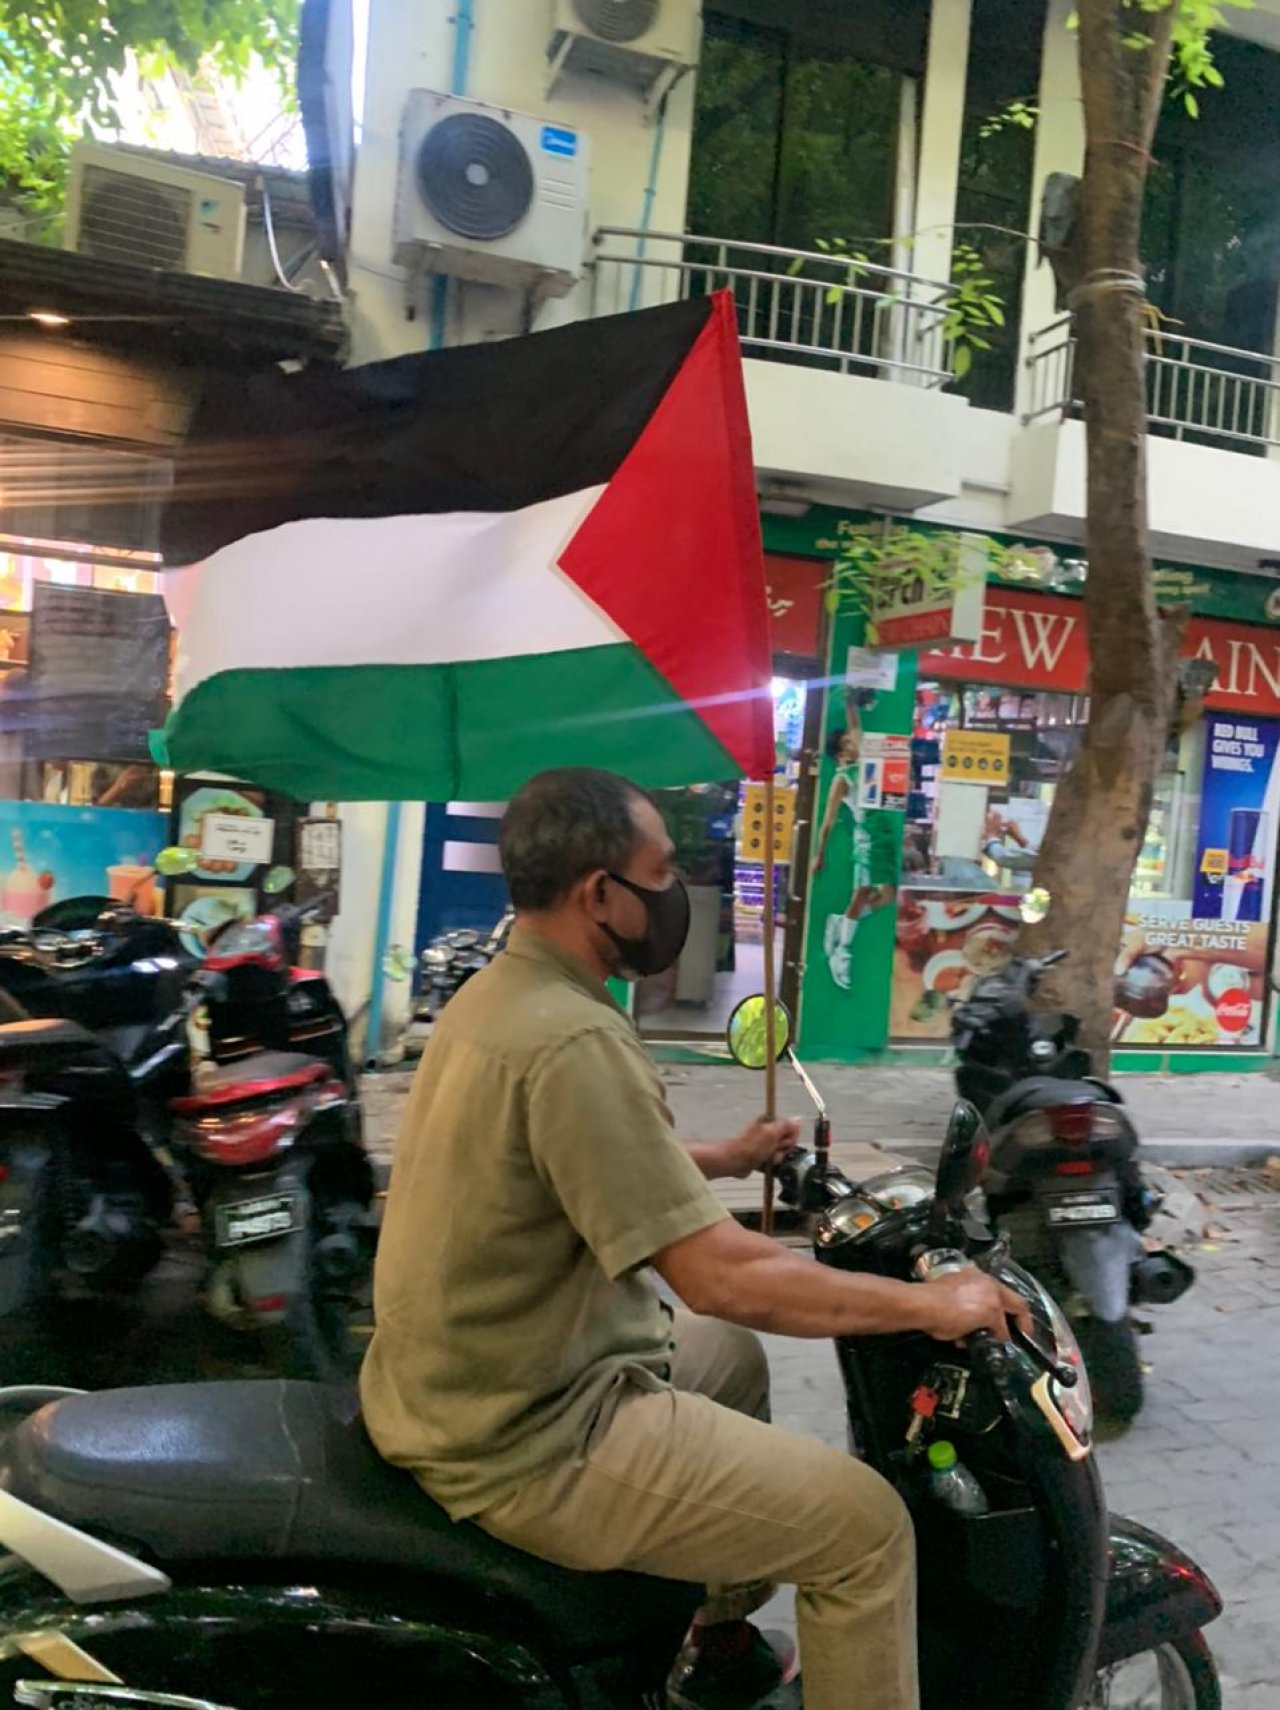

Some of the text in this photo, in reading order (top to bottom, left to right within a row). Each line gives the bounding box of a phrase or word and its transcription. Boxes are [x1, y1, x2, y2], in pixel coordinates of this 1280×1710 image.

[929, 605, 1078, 672] EW
[1213, 723, 1257, 741] RED BULL
[1212, 740, 1265, 758] GIVES YOU
[1140, 914, 1251, 934] SERVE GUESTS
[1145, 931, 1248, 951] GREAT TASTE
